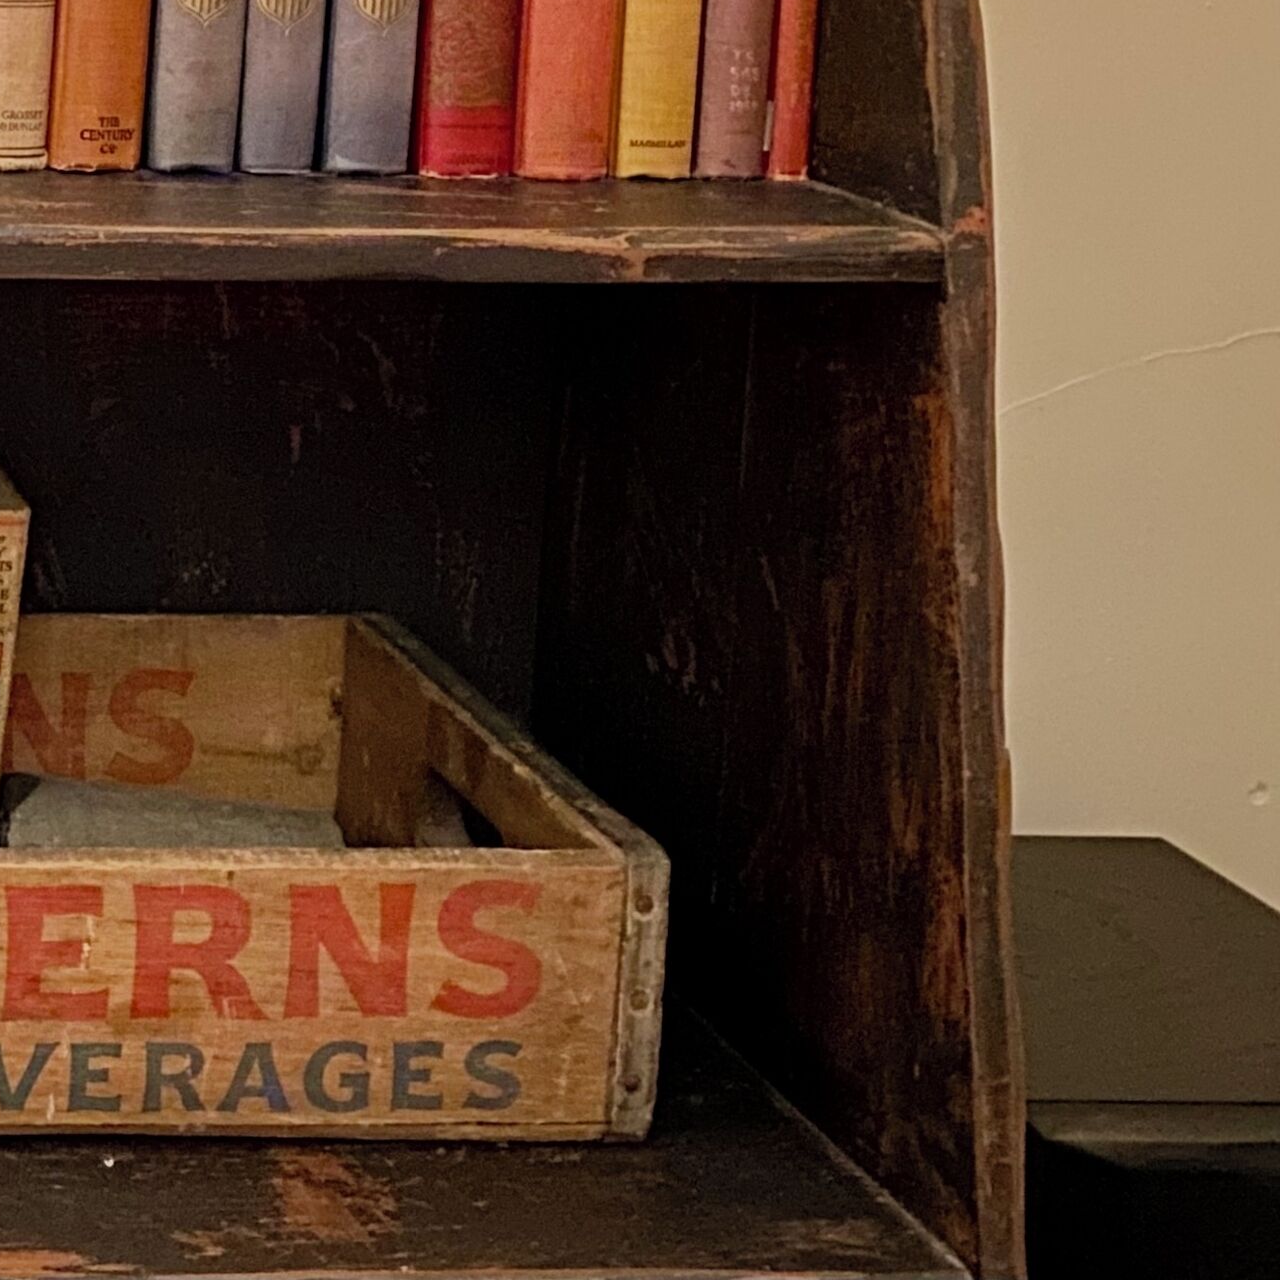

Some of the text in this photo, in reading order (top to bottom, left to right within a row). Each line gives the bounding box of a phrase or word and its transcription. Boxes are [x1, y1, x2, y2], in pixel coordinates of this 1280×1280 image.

[99, 117, 120, 128] THE
[80, 129, 135, 142] CENTURY
[629, 138, 687, 149] MACMILLAN
